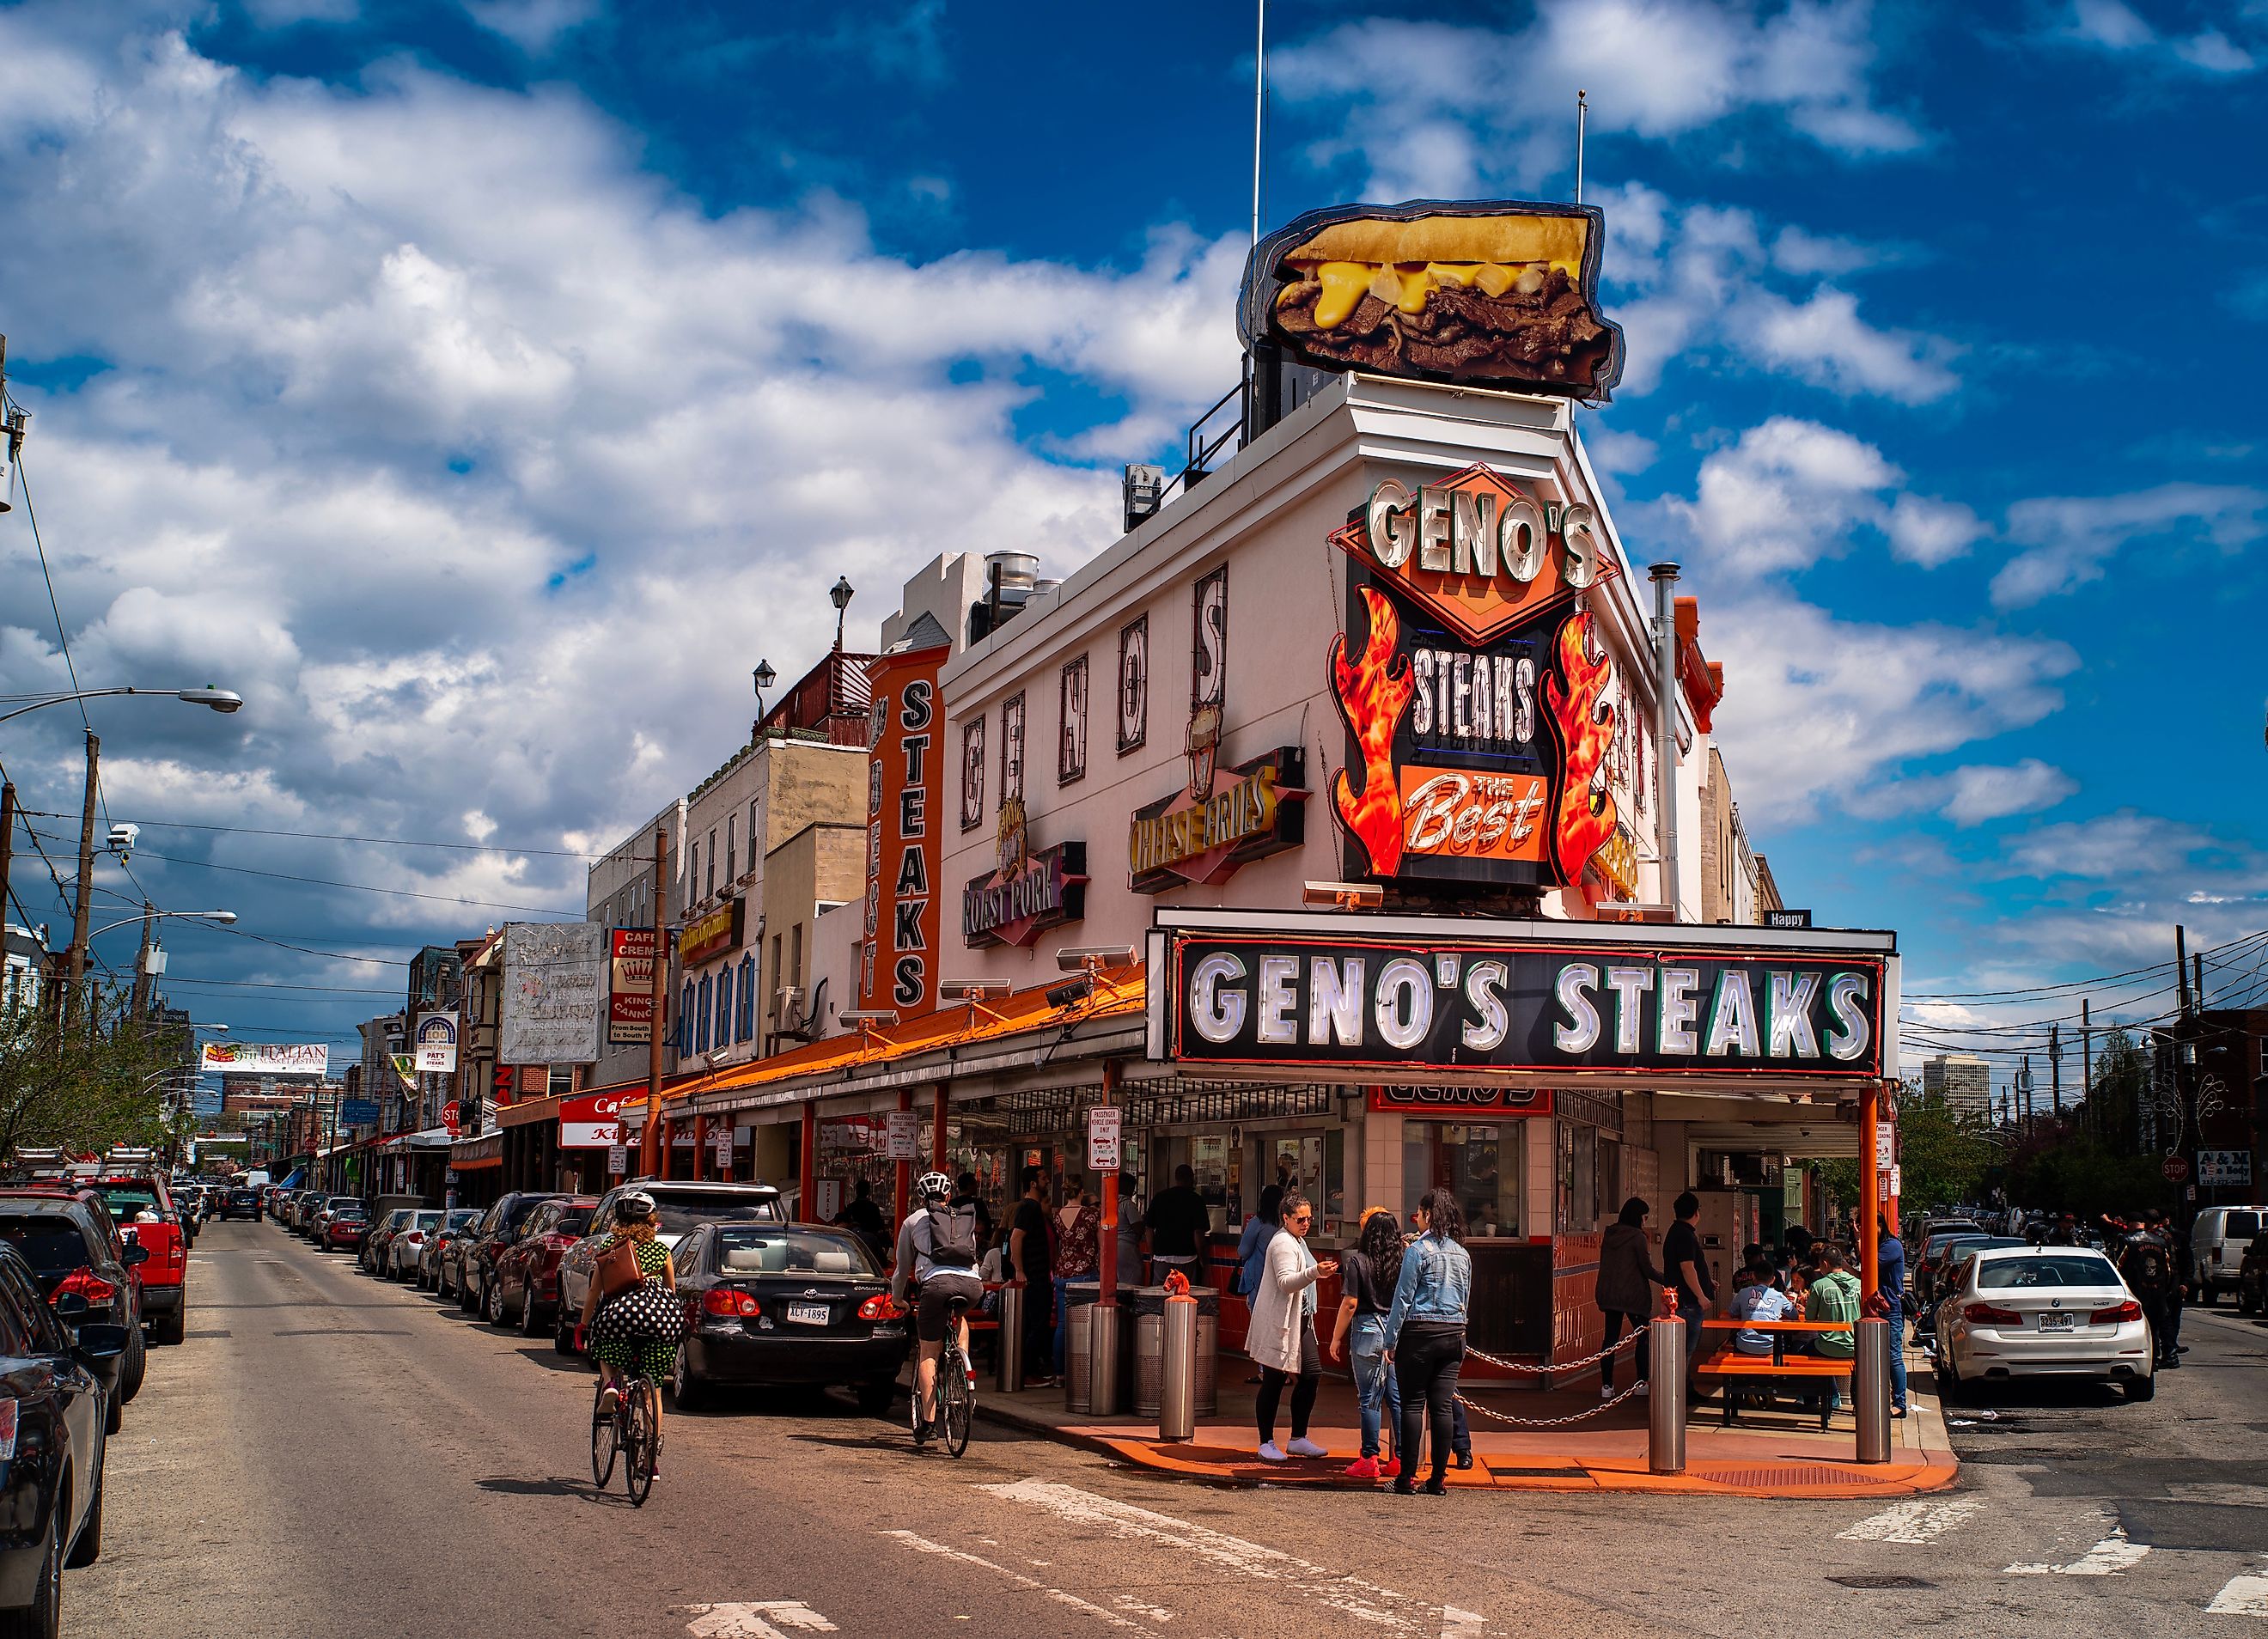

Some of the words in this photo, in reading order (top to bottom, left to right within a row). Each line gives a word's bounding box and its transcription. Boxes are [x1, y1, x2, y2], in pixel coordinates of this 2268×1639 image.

[1366, 478, 1597, 589] GENO'S
[1412, 647, 1538, 746] STEAKS
[1472, 775, 1515, 795] THE
[1204, 765, 1271, 849] FRIES
[1404, 772, 1546, 850] Best
[892, 679, 933, 1008] STEAKS
[962, 885, 1007, 935] ROAST
[1010, 861, 1054, 921] PORK
[1771, 912, 1804, 927] Happy
[619, 945, 655, 955] CREM
[1189, 951, 1508, 1051] GENO'S
[1553, 960, 1870, 1062] STEAKS
[260, 1045, 326, 1058] ITALIAN
[443, 1109, 459, 1121] ST
[2200, 1152, 2216, 1165] A
[2216, 1152, 2228, 1165] &
[2232, 1152, 2249, 1165] M
[2164, 1165, 2186, 1173] STOP
[2200, 1166, 2223, 1175] Ao
[2226, 1166, 2249, 1176] Body
